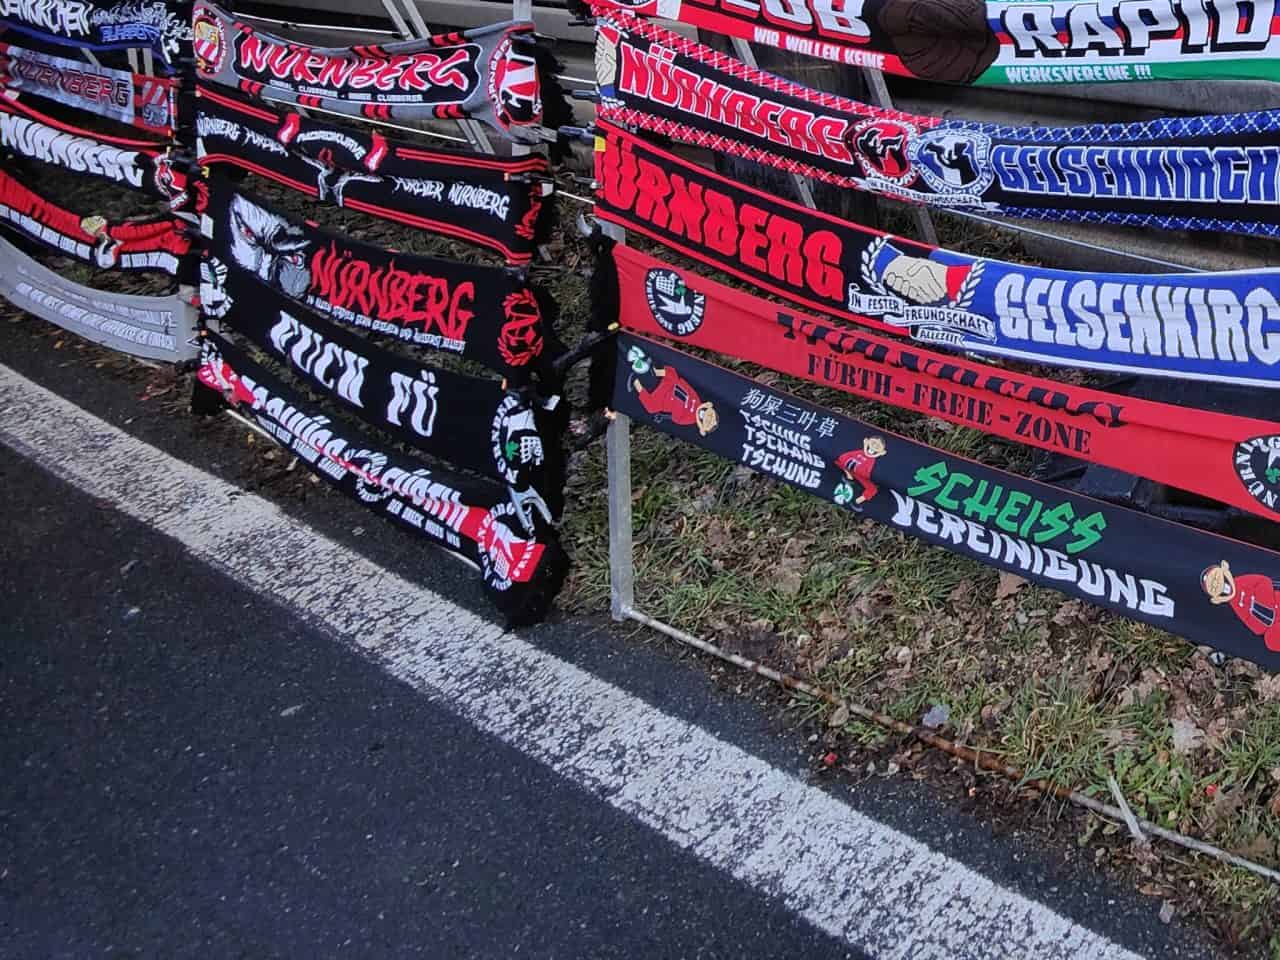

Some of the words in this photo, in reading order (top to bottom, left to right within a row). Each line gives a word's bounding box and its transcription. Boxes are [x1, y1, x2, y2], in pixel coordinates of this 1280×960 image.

[754, 26, 781, 48] WIR
[785, 32, 841, 60] WOLLEN
[843, 45, 885, 70] KEINE
[1005, 65, 1132, 84] WERKSVEREINE
[618, 43, 856, 166] NÜRNBERG
[849, 294, 864, 309] IN
[867, 297, 900, 312] FESTER
[904, 308, 989, 331] FREUNDSCHAFT
[270, 310, 369, 408] FUCK
[808, 352, 892, 397] FÜRTH
[911, 383, 993, 425] FREIE
[1014, 404, 1092, 454] ZONE
[742, 443, 821, 488] TSCHUNG
[906, 461, 1106, 554] SCHEISS
[890, 490, 1175, 618] VEREINIGUNG
